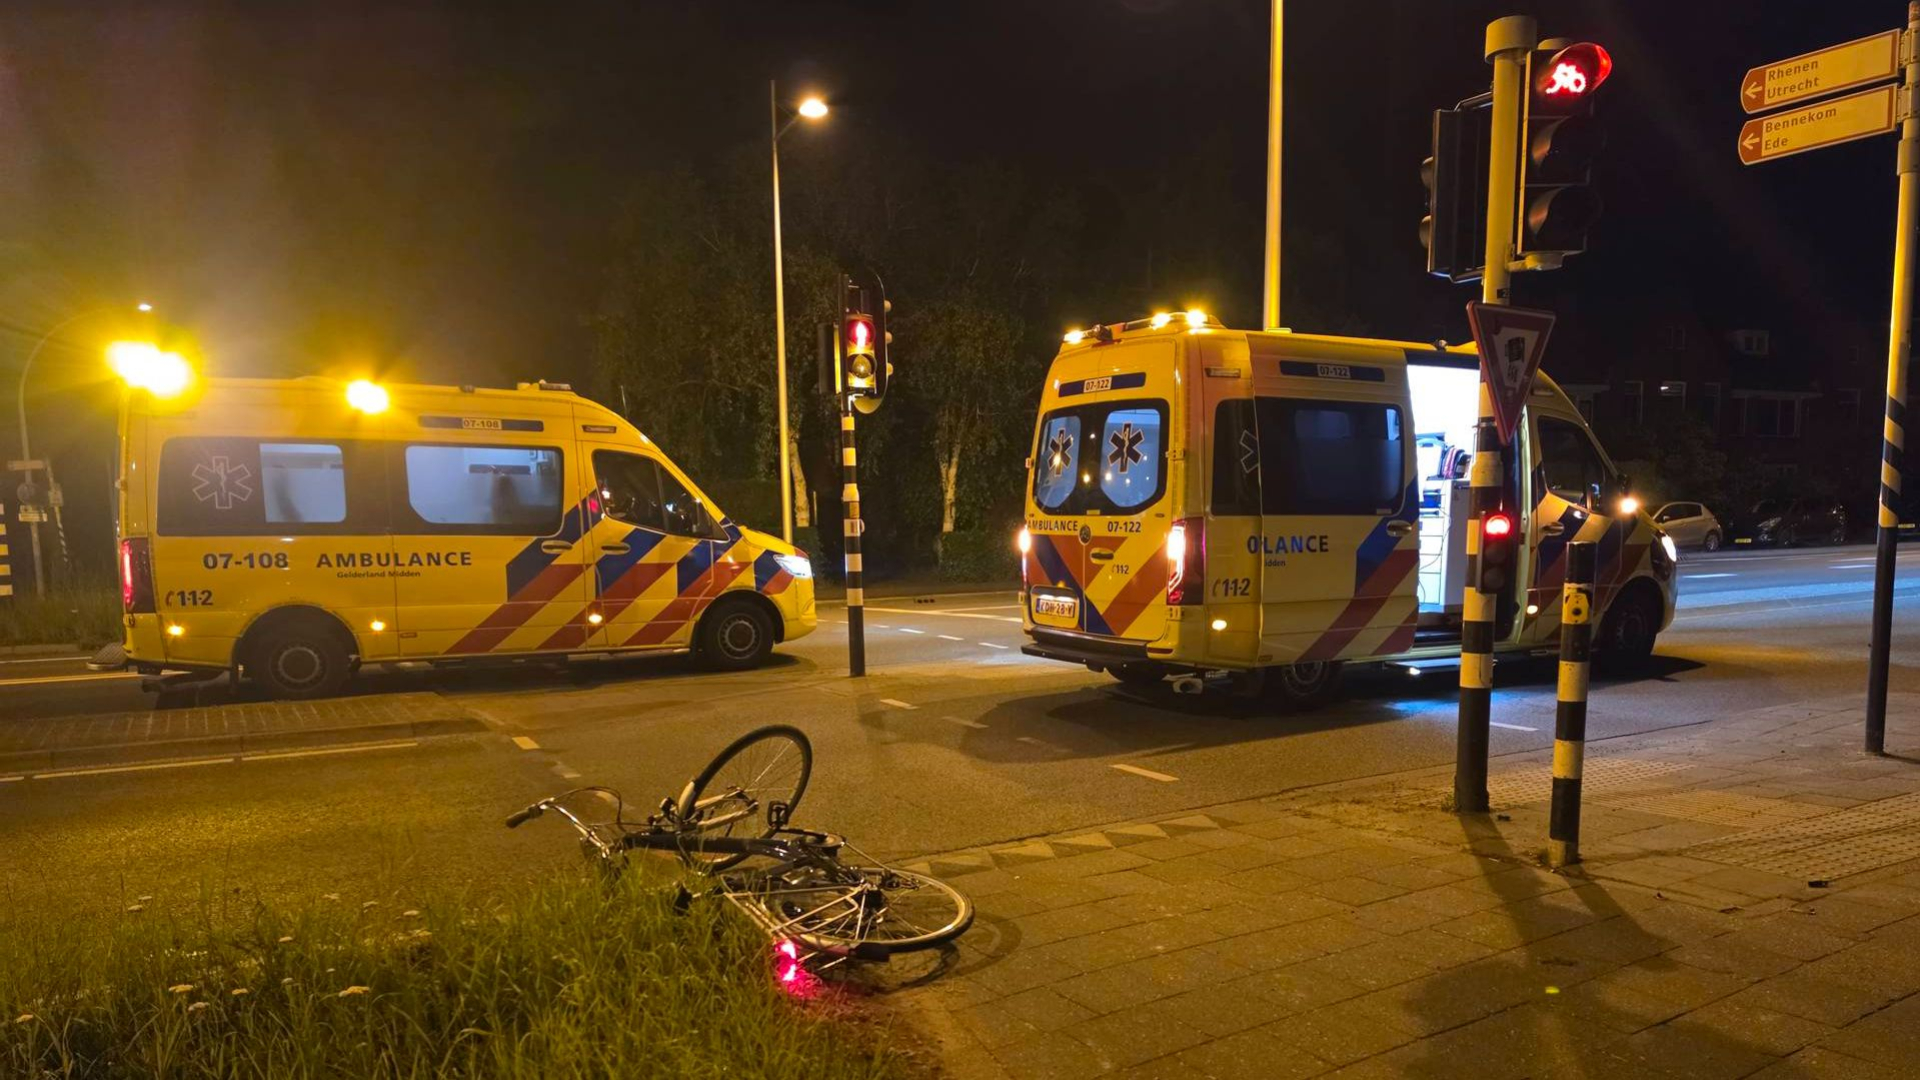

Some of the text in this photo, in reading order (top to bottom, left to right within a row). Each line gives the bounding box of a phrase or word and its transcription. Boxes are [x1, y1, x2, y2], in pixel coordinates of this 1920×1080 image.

[1768, 61, 1818, 81] Rhenen
[1767, 77, 1819, 99] Utrecht
[1765, 108, 1837, 133] Bennekom
[1764, 137, 1789, 151] Ede
[1319, 365, 1349, 377] 07-122
[1085, 379, 1110, 391] 07-122
[464, 419, 499, 428] 07-108
[1028, 520, 1078, 531] AMBULANCE
[1107, 521, 1142, 533] 07-122
[203, 552, 289, 569] 07-108
[316, 551, 473, 568] AMBULANCE
